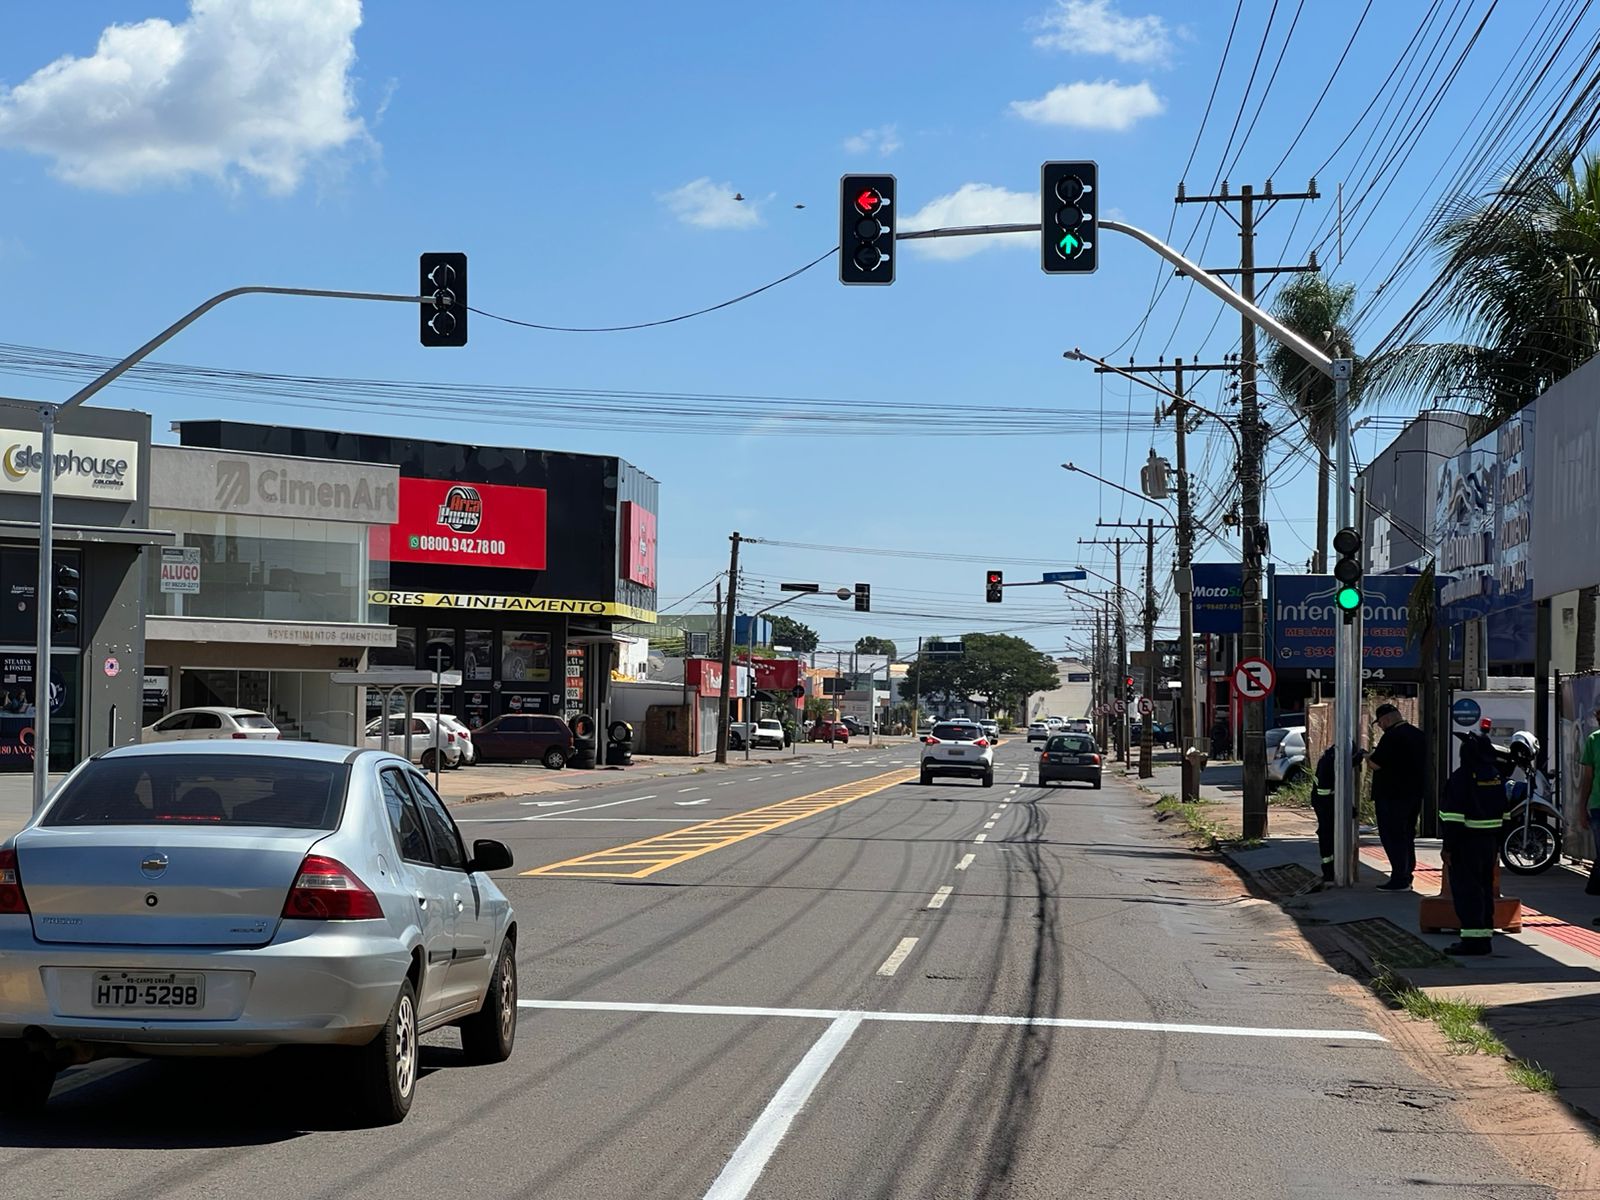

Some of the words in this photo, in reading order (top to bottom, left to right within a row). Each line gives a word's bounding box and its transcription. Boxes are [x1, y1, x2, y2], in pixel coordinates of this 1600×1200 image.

[15, 445, 128, 477] slephouse
[257, 468, 396, 511] CimenArt
[162, 565, 199, 581] ALUGO
[436, 594, 606, 613] ALINHAMENTO
[267, 629, 336, 641] REVESTIMENTOS
